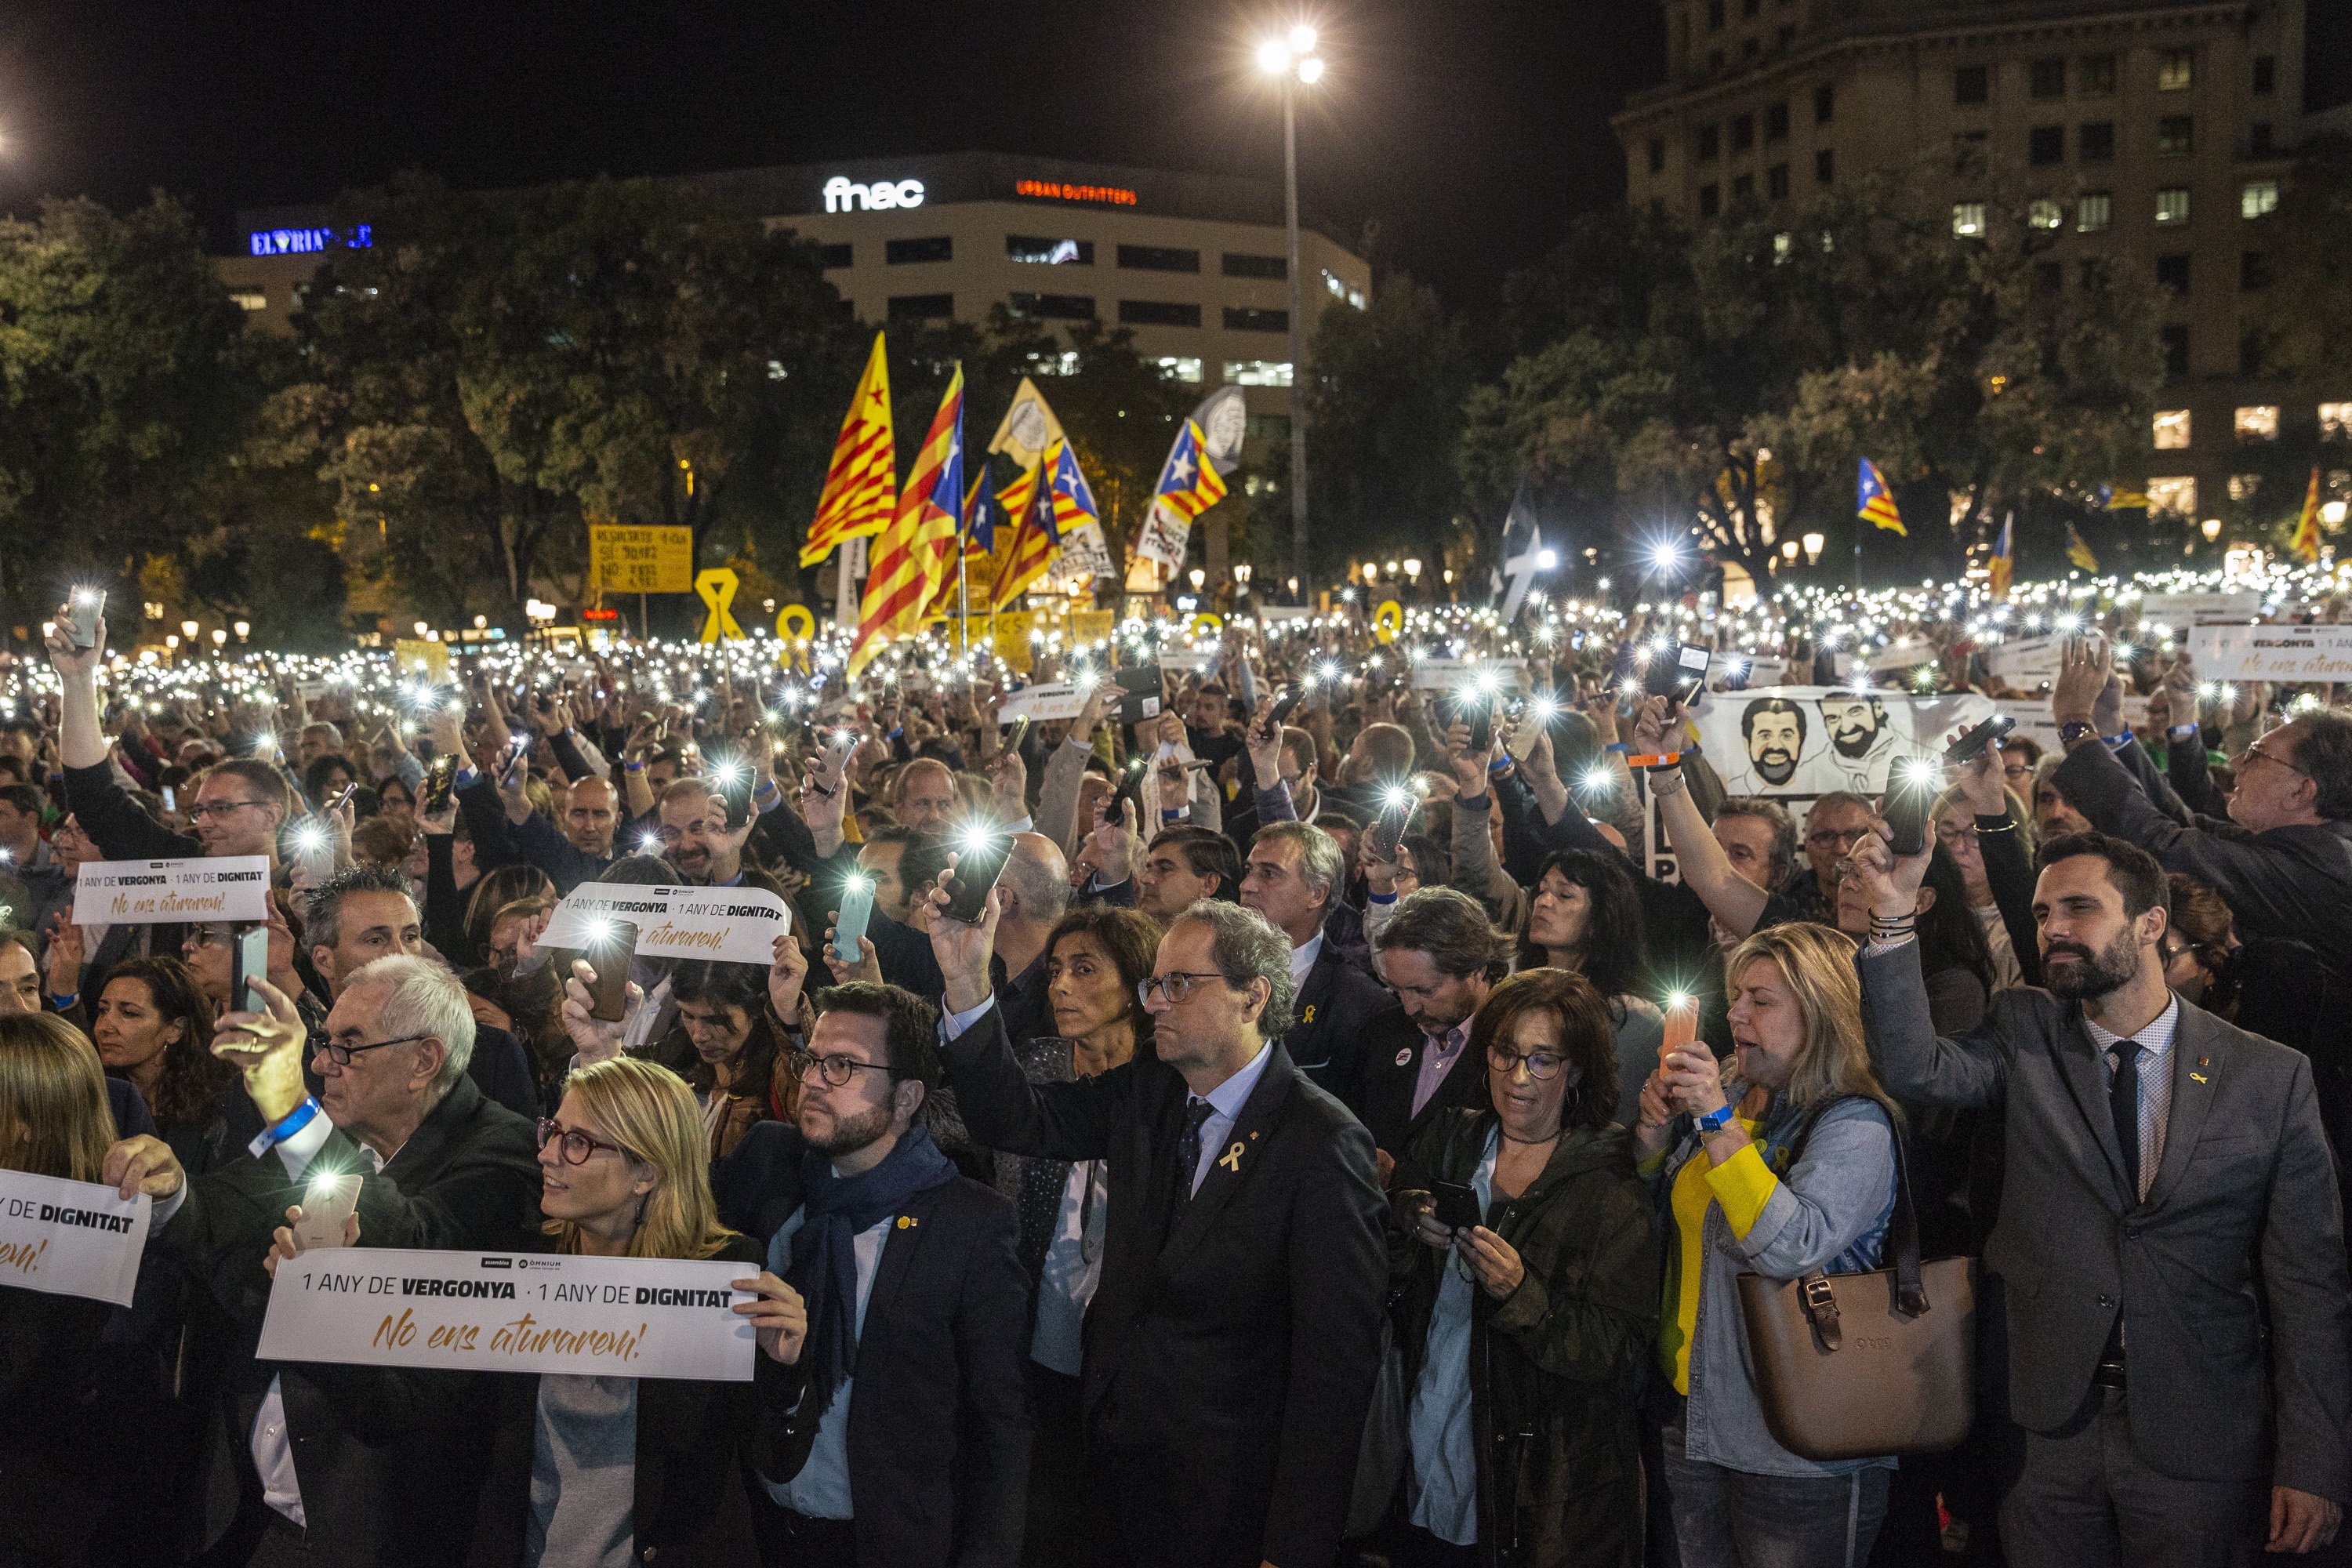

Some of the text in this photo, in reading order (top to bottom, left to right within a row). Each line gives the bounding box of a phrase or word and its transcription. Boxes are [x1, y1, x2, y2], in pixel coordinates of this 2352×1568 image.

[823, 176, 924, 213] fnac
[1016, 180, 1061, 198] URBAN
[85, 877, 103, 887] ANY
[104, 877, 118, 887] DE
[118, 875, 167, 886] VERGONYA
[176, 874, 180, 884] 1
[183, 873, 201, 884] ANY
[203, 873, 216, 883] DE
[217, 871, 263, 882] DIGNITAT
[111, 892, 128, 915] No
[133, 898, 155, 913] ens
[565, 898, 782, 921] 1 ANY DE VERGONYA 1 ANY DE DIGNITAT
[645, 920, 730, 951] aturarem!
[9, 1199, 134, 1234] DE DIGNITAT
[303, 1272, 732, 1308] 1 ANY DE VERGONYA 1 ANY DE DIGNITAT
[372, 1307, 648, 1363] No ens aturarem!
